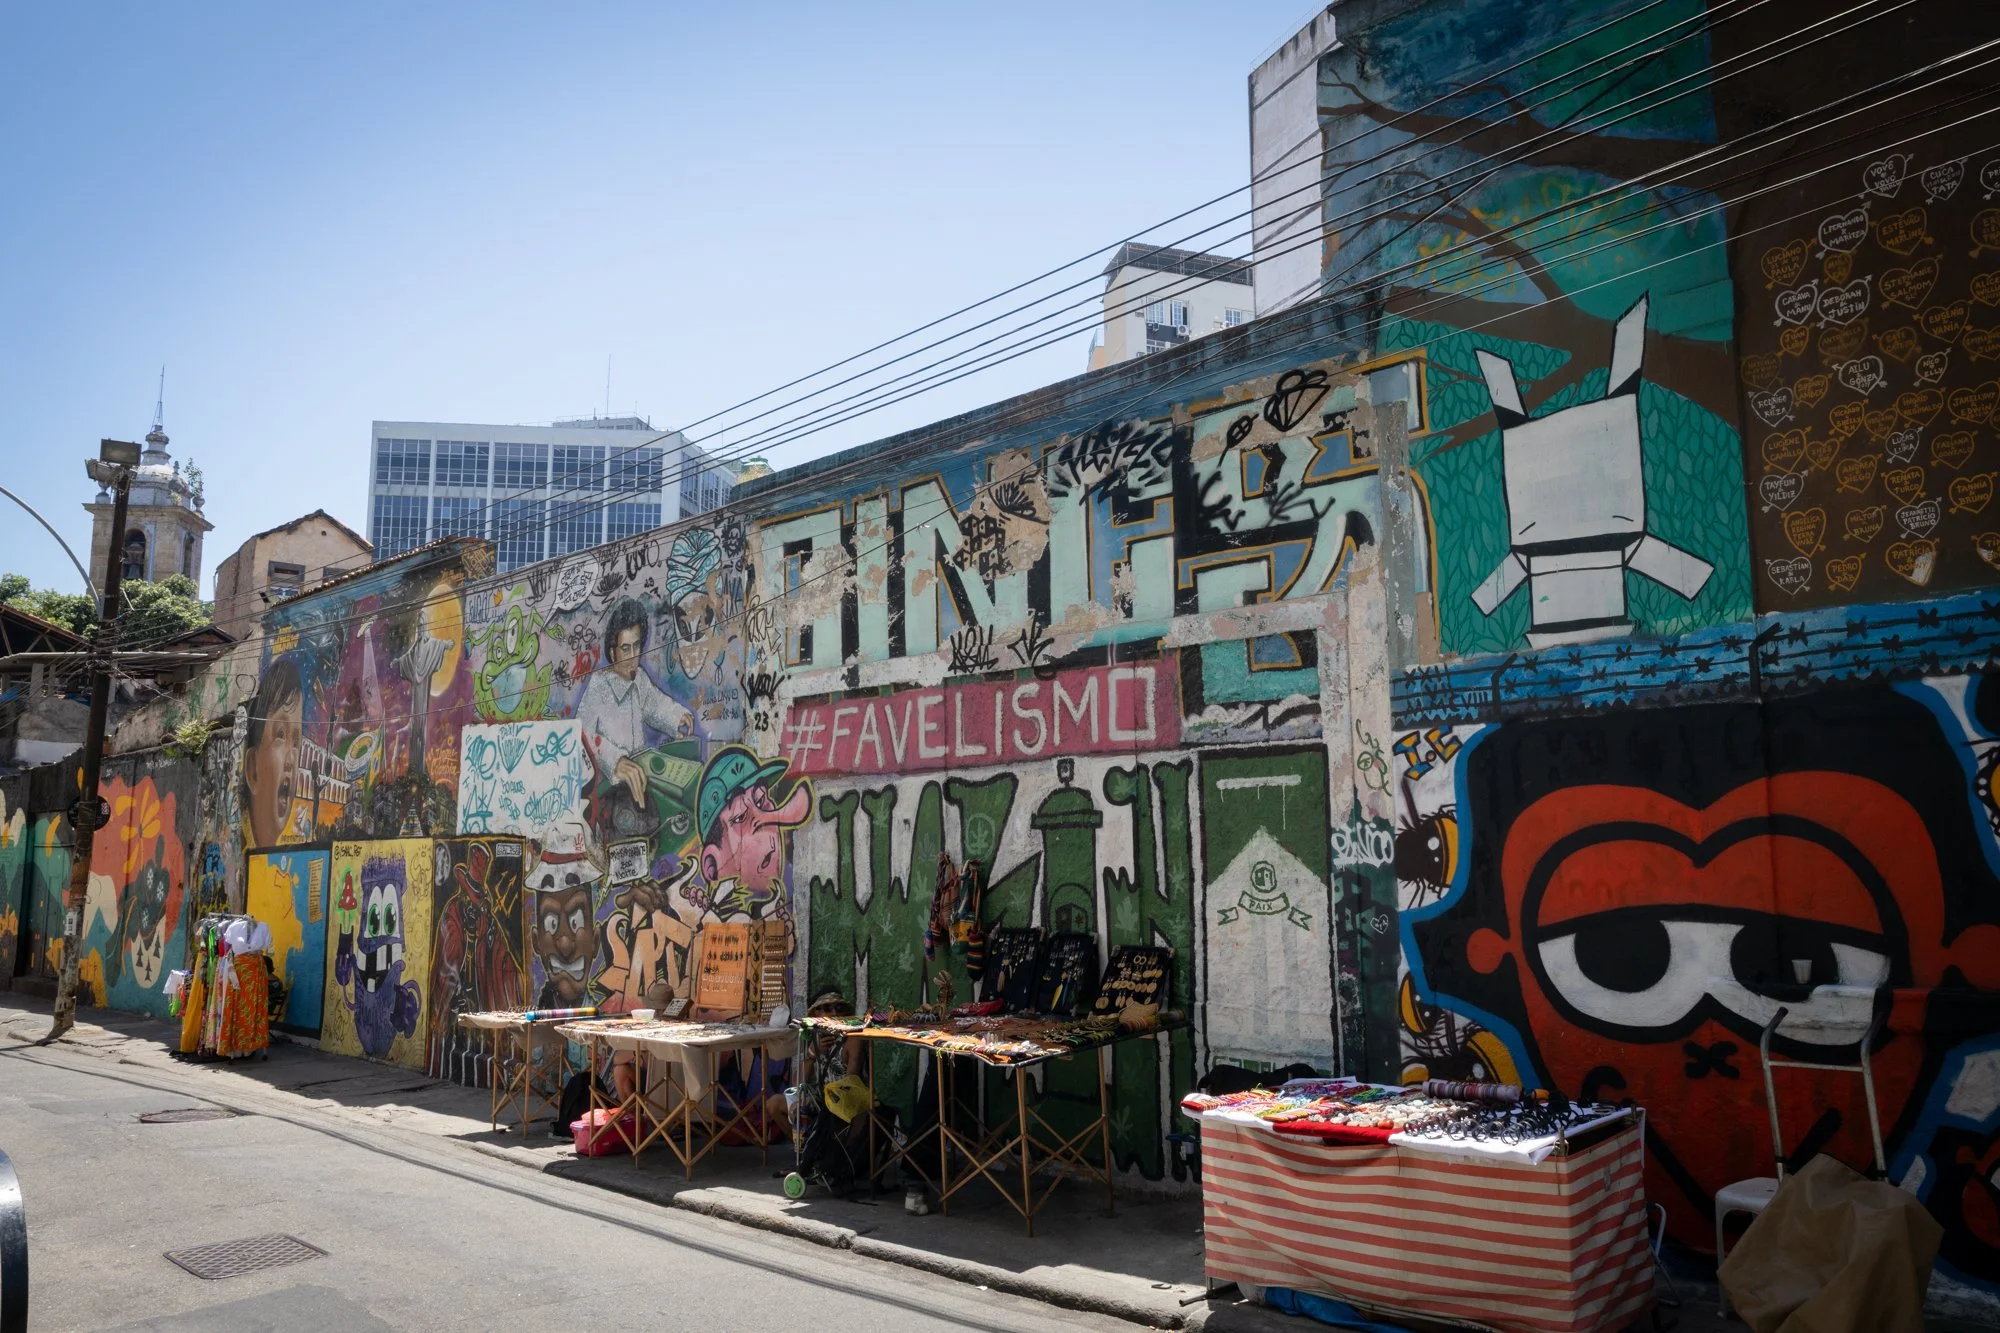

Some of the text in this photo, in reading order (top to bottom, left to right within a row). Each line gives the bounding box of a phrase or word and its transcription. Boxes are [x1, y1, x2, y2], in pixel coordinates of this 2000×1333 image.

[1929, 166, 1955, 180] CUCA
[1931, 180, 1959, 195] TATA
[1770, 262, 1799, 278] PAULA
[1822, 289, 1862, 308] DEBORAH
[1891, 433, 1915, 445] LUCAS
[1765, 478, 1796, 490] TAYFUN
[1853, 523, 1880, 536] BRUNA
[1909, 519, 1936, 530] BRUNO
[1771, 562, 1809, 574] SEBASTIAN
[1779, 576, 1805, 585] KARLA
[754, 710, 769, 732] 23
[786, 667, 1157, 776] #FAVELISMO
[1250, 900, 1273, 911] PAIX
